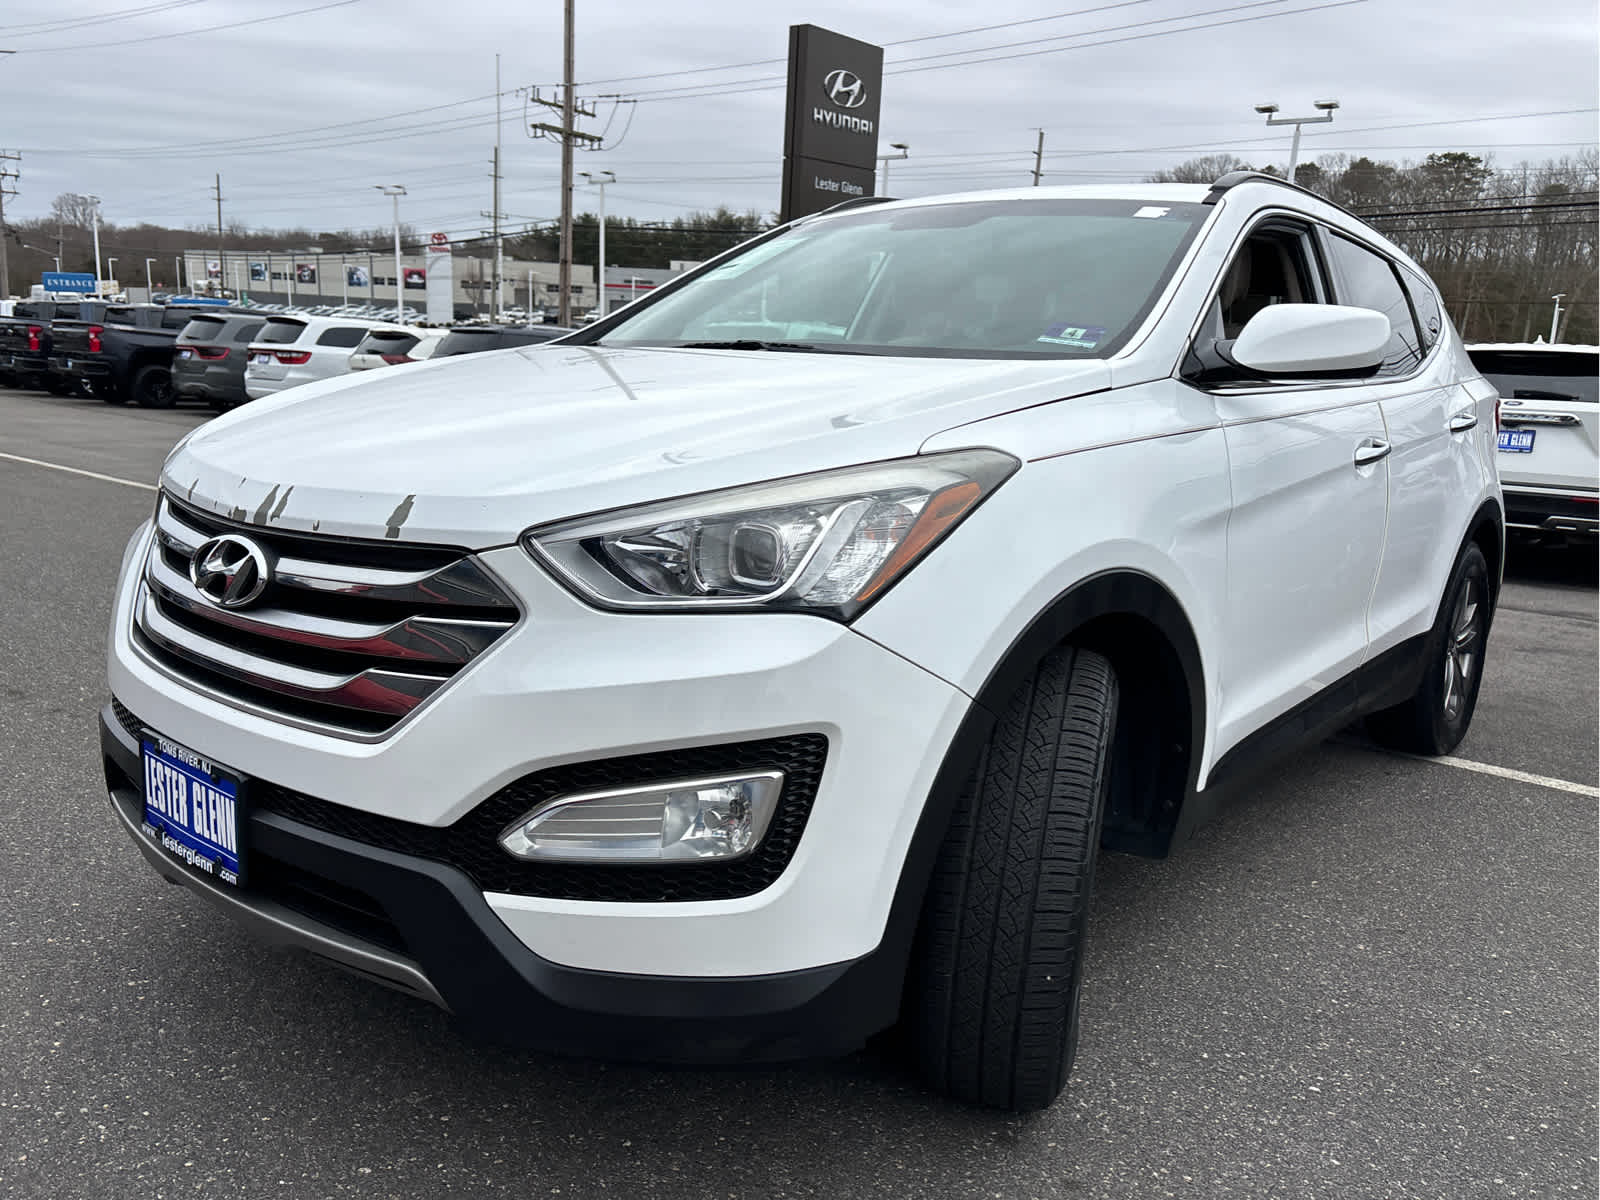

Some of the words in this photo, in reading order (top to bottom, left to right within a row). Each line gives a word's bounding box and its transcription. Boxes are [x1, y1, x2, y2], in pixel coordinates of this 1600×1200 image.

[813, 107, 873, 134] HYUNDAI
[815, 176, 840, 192] Lester
[841, 181, 863, 196] Glenn
[47, 279, 93, 287] ENTRANCE
[1510, 434, 1533, 447] GLENN
[158, 739, 178, 759] TOMS
[201, 759, 212, 775] NJ
[144, 754, 188, 828] LESTER
[192, 781, 237, 854] GLENN
[161, 832, 213, 875] lesterglenn
